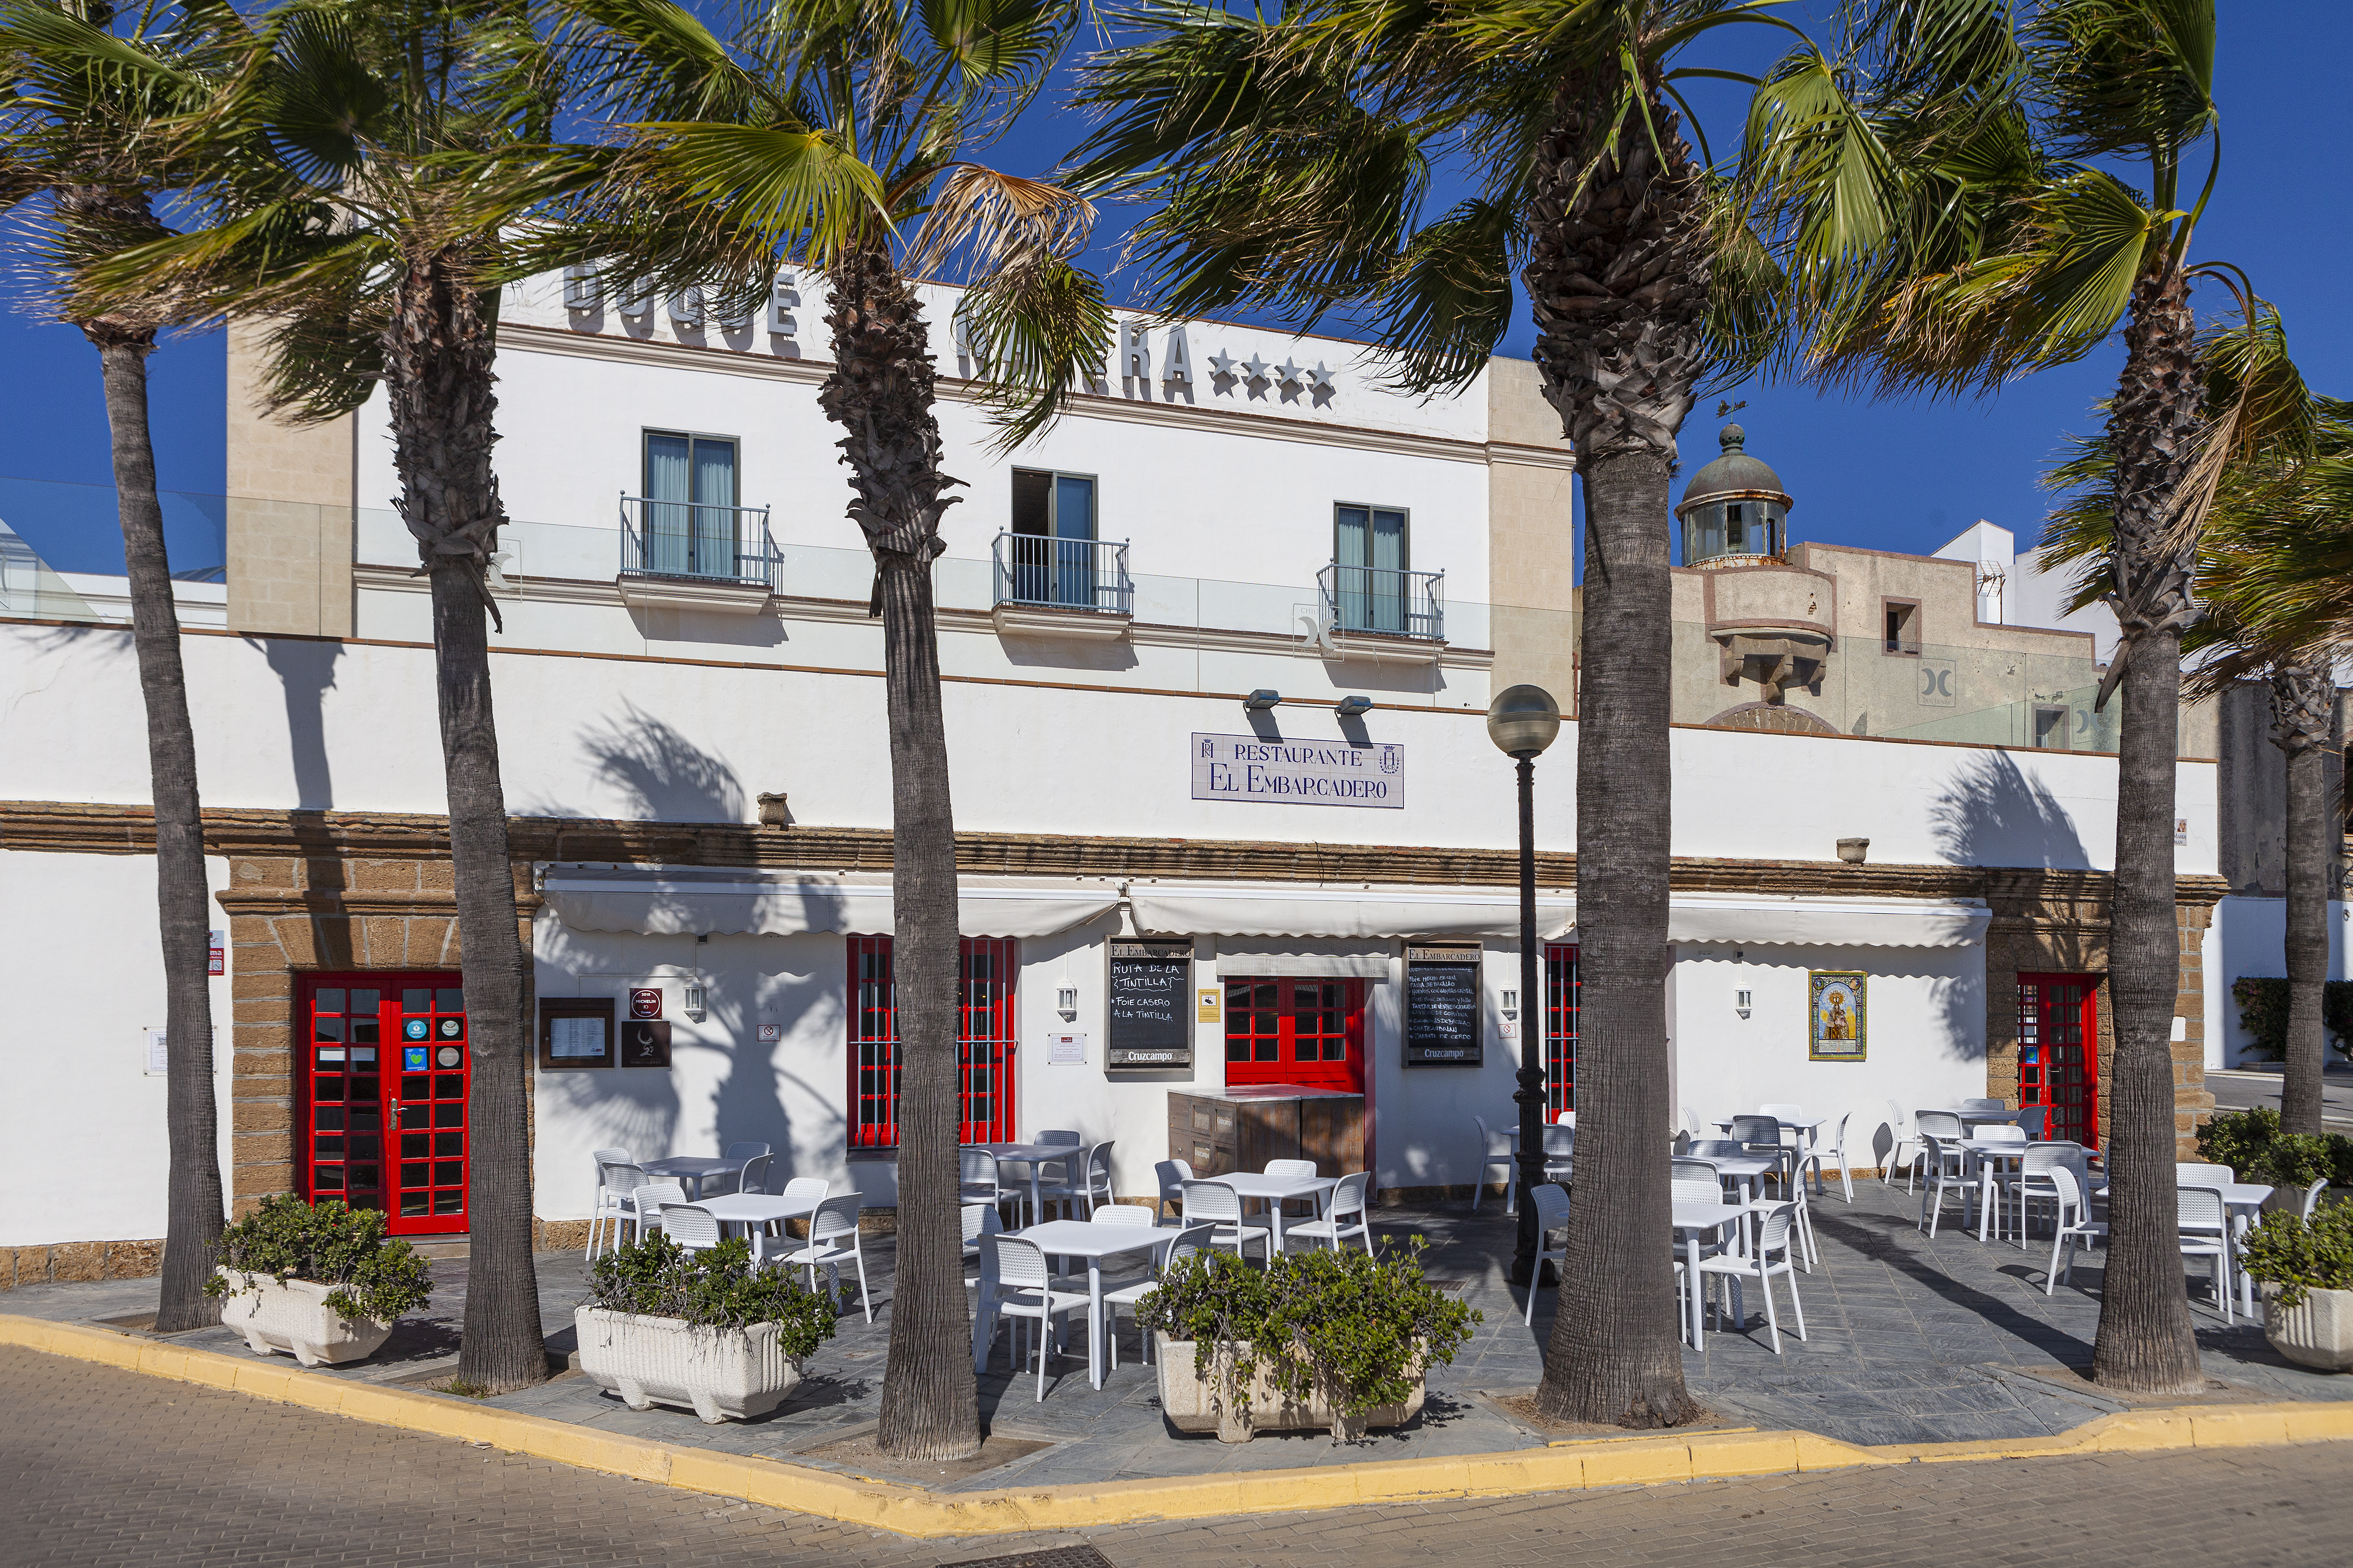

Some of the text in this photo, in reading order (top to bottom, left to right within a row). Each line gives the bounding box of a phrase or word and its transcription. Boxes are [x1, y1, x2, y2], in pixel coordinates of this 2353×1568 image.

[1235, 744, 1362, 766] RESTAURANTE
[1247, 765, 1387, 799] EMBARCADERO
[1127, 945, 1191, 958] EMBARCADERO
[1422, 949, 1480, 960] EMBARCADERO
[1112, 962, 1142, 974] RUTA
[1165, 965, 1180, 974] LA
[1114, 1009, 1120, 1018] A
[1128, 1051, 1173, 1062] Cruzcampo
[1425, 1049, 1464, 1059] Cruzcampo
[1217, 1117, 1233, 1127] Cruzcampo
[1195, 1149, 1210, 1159] Cruzcampo
